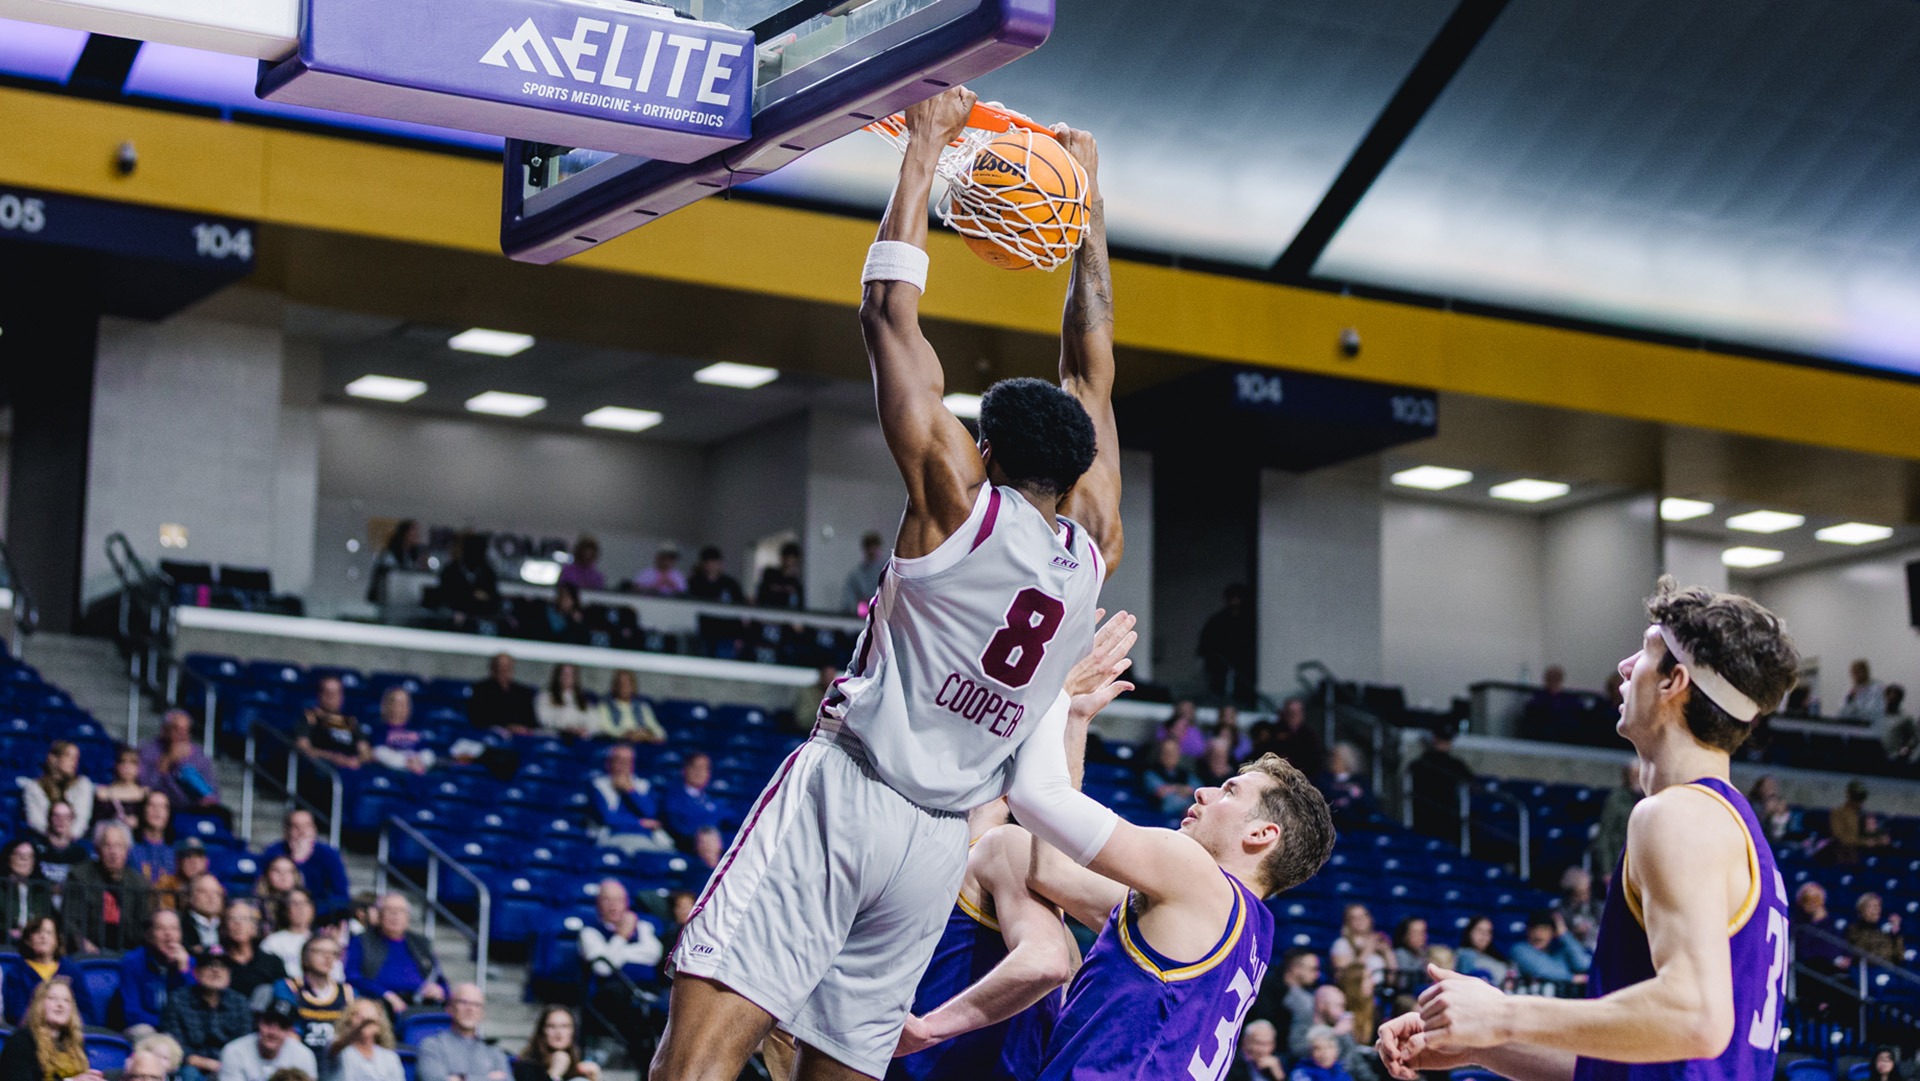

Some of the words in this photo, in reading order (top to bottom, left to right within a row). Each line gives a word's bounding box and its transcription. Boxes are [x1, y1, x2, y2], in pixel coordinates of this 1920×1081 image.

[552, 16, 743, 106] ELITE
[522, 82, 568, 101] SPORTS
[571, 90, 630, 112] MEDICINE
[643, 104, 724, 128] ORTHOPEDICS
[968, 151, 1026, 182] ilson
[0, 194, 45, 232] 05
[192, 223, 252, 261] 104
[1235, 373, 1282, 404] 104
[1053, 556, 1079, 569] EKU
[978, 585, 1065, 690] 8
[935, 672, 1024, 738] COOPER
